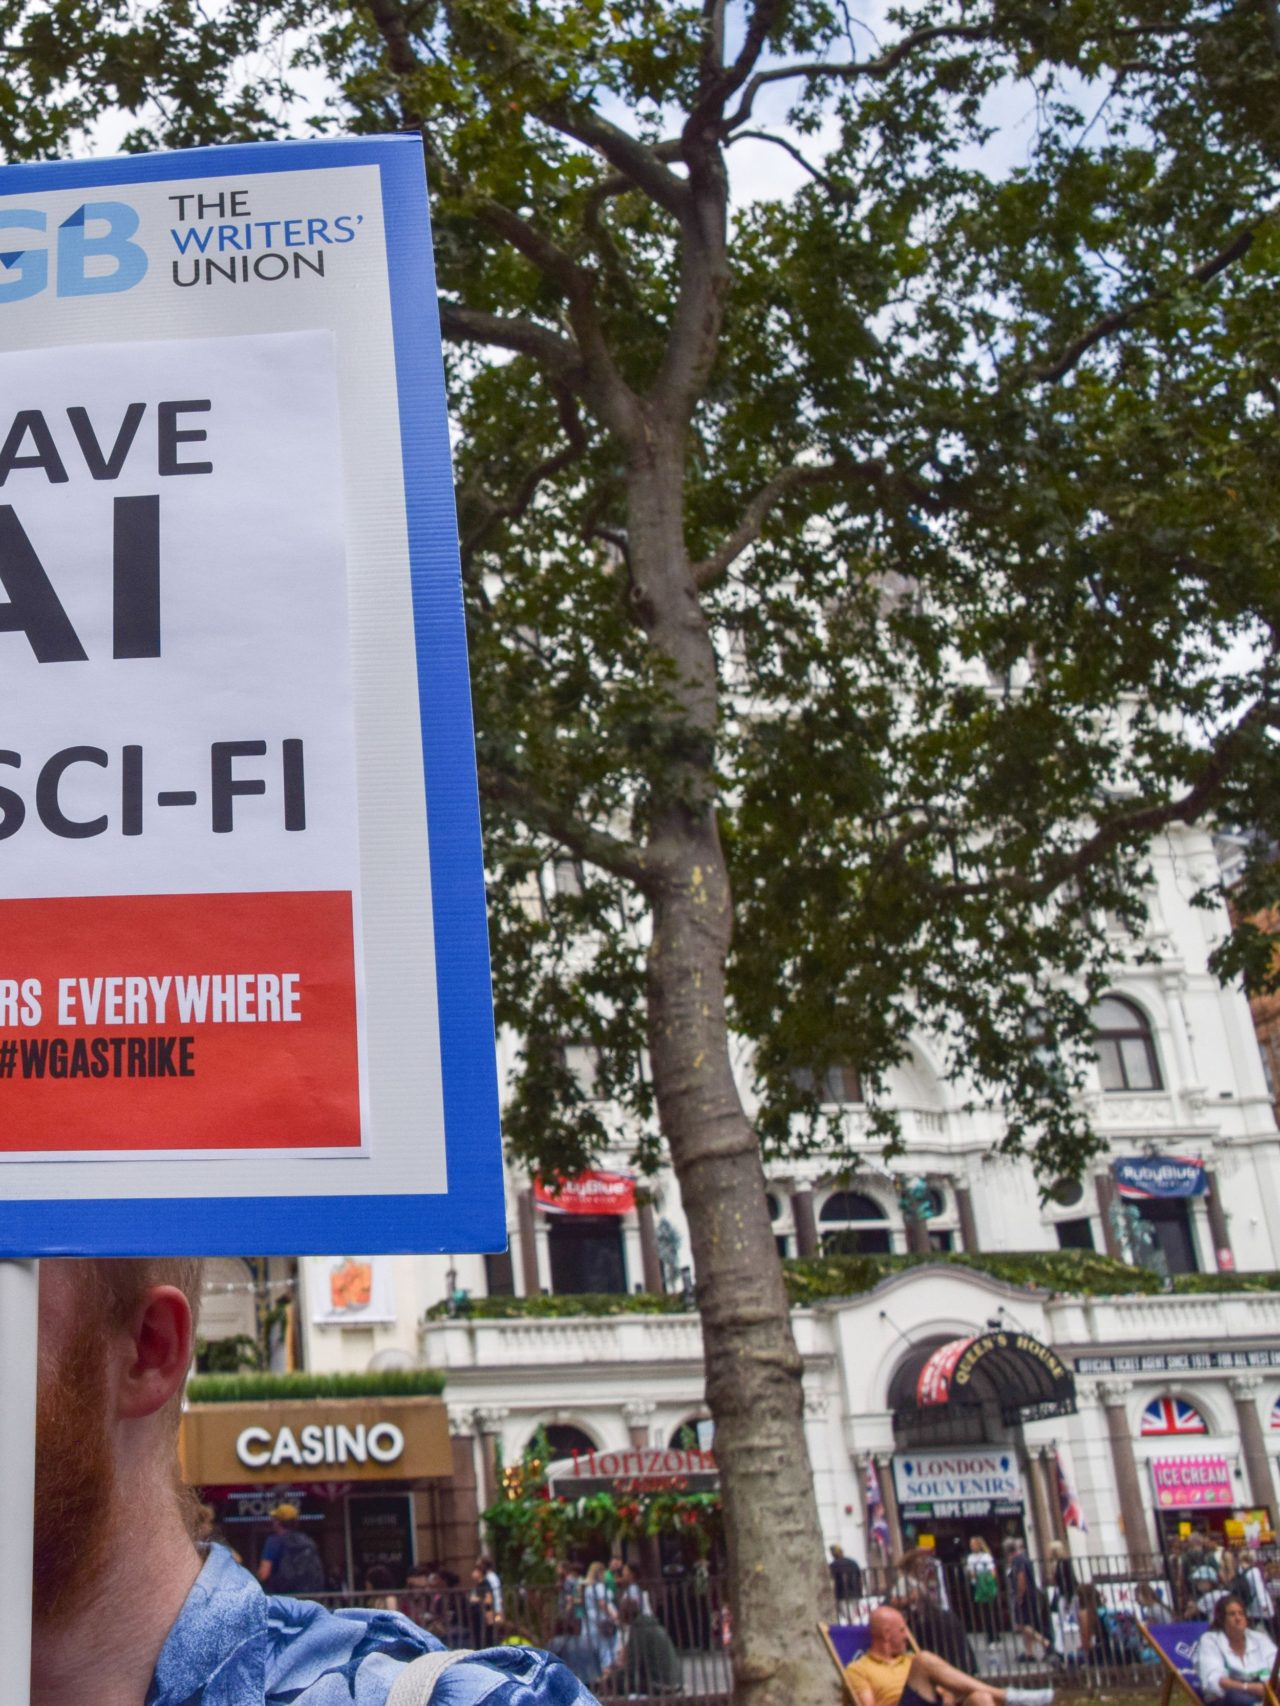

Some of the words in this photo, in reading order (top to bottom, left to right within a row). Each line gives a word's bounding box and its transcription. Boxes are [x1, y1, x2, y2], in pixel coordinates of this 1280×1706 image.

[168, 190, 252, 222] THE
[171, 250, 326, 288] UNION
[57, 973, 302, 1027] EVERYWHERE
[955, 1333, 1008, 1385] QUEEN'S
[1016, 1336, 1065, 1380] HOUSE
[236, 1422, 405, 1467] CASINO
[916, 1458, 997, 1477] LONDON
[1158, 1467, 1179, 1488] ICE
[1181, 1466, 1227, 1487] CREAM
[906, 1478, 1016, 1496] SOUVENIRS
[932, 1501, 960, 1519] VAPE
[961, 1500, 991, 1517] SHOP
